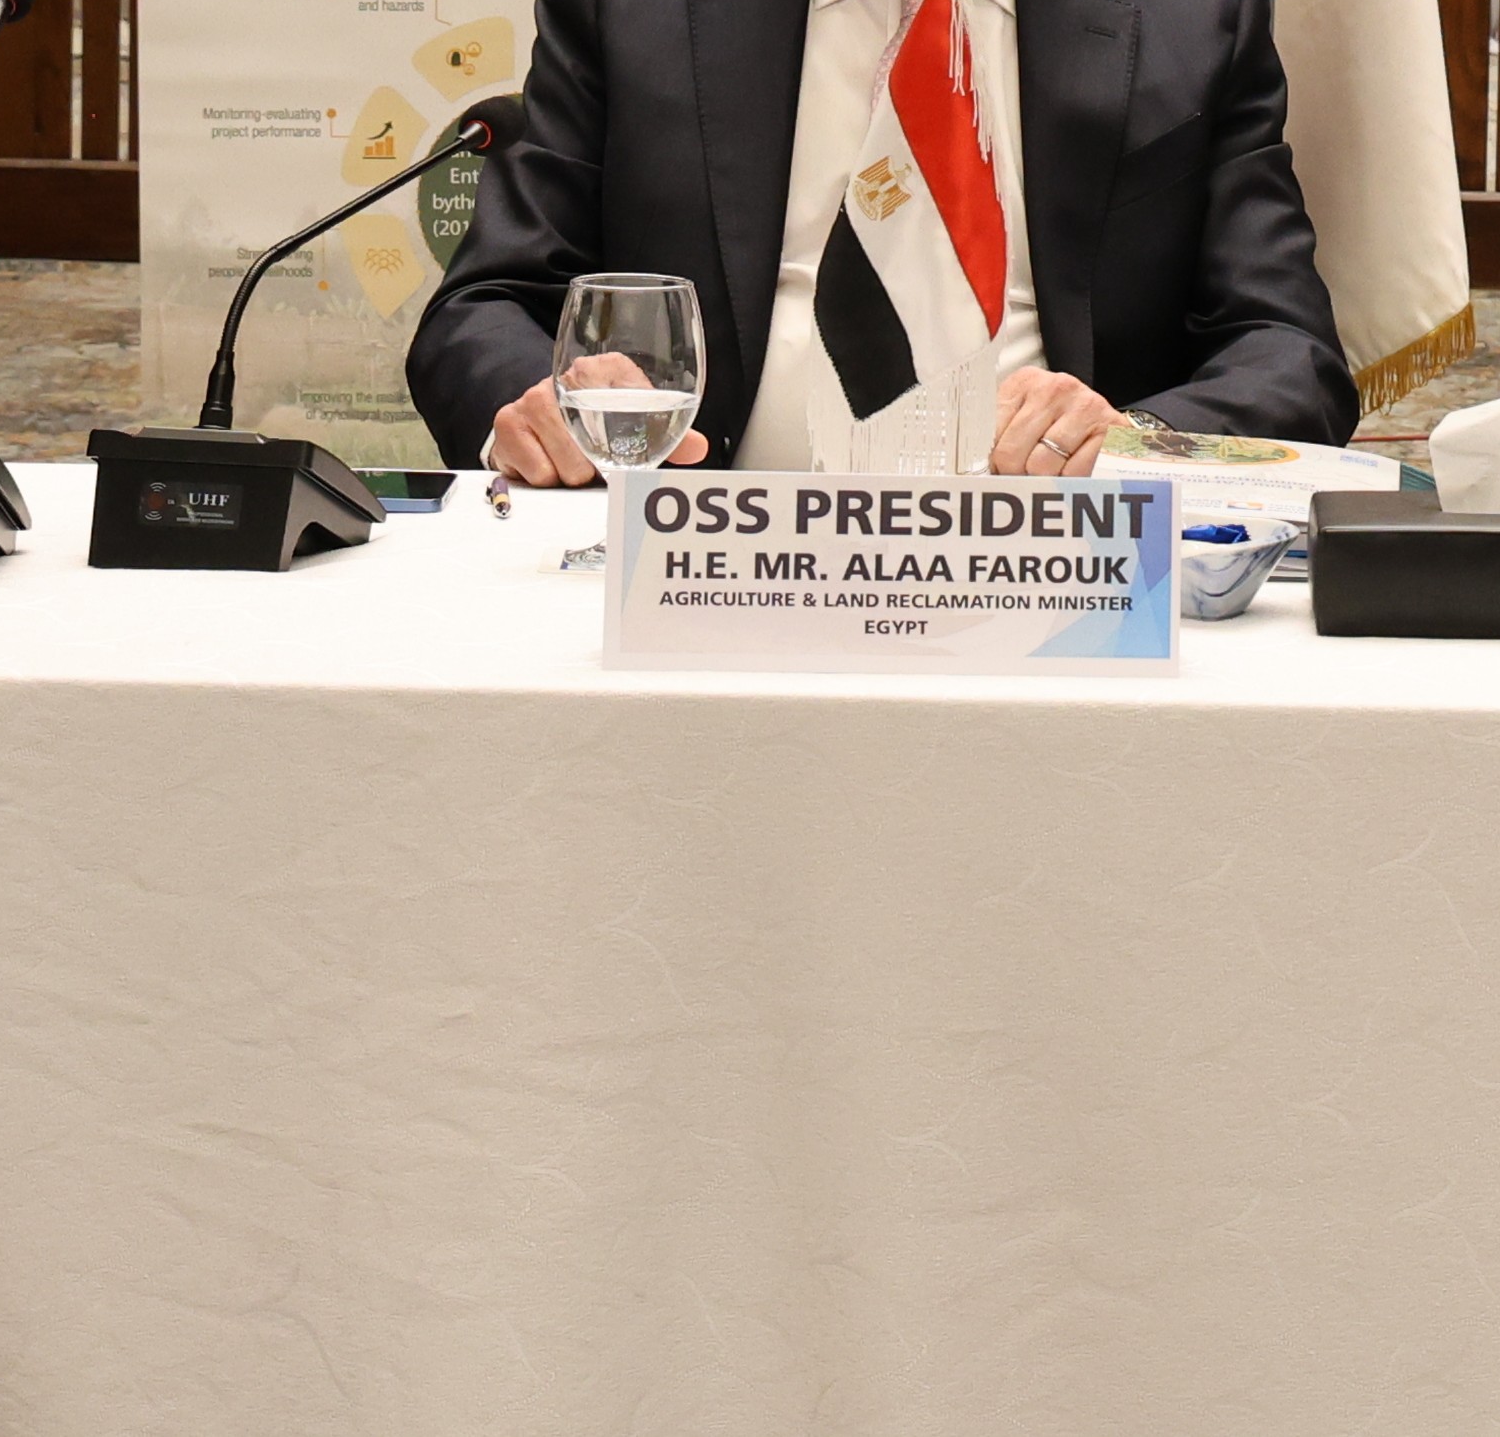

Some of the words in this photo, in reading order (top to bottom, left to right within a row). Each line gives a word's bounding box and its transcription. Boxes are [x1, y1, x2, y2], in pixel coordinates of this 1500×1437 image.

[189, 493, 229, 506] UHF
[644, 487, 770, 534] OSS
[796, 489, 1155, 539] PRESIDENT
[666, 551, 737, 579] H.E.
[755, 552, 827, 580] MR.
[843, 554, 953, 582] ALAA
[969, 555, 1128, 584] FAROUK
[660, 591, 794, 607] AGRICULTURE
[803, 593, 816, 607] &
[824, 593, 879, 608] LAND
[886, 594, 1030, 609] RECLAMATION
[1039, 596, 1133, 612] MINISTER
[865, 620, 928, 635] EGYPT
